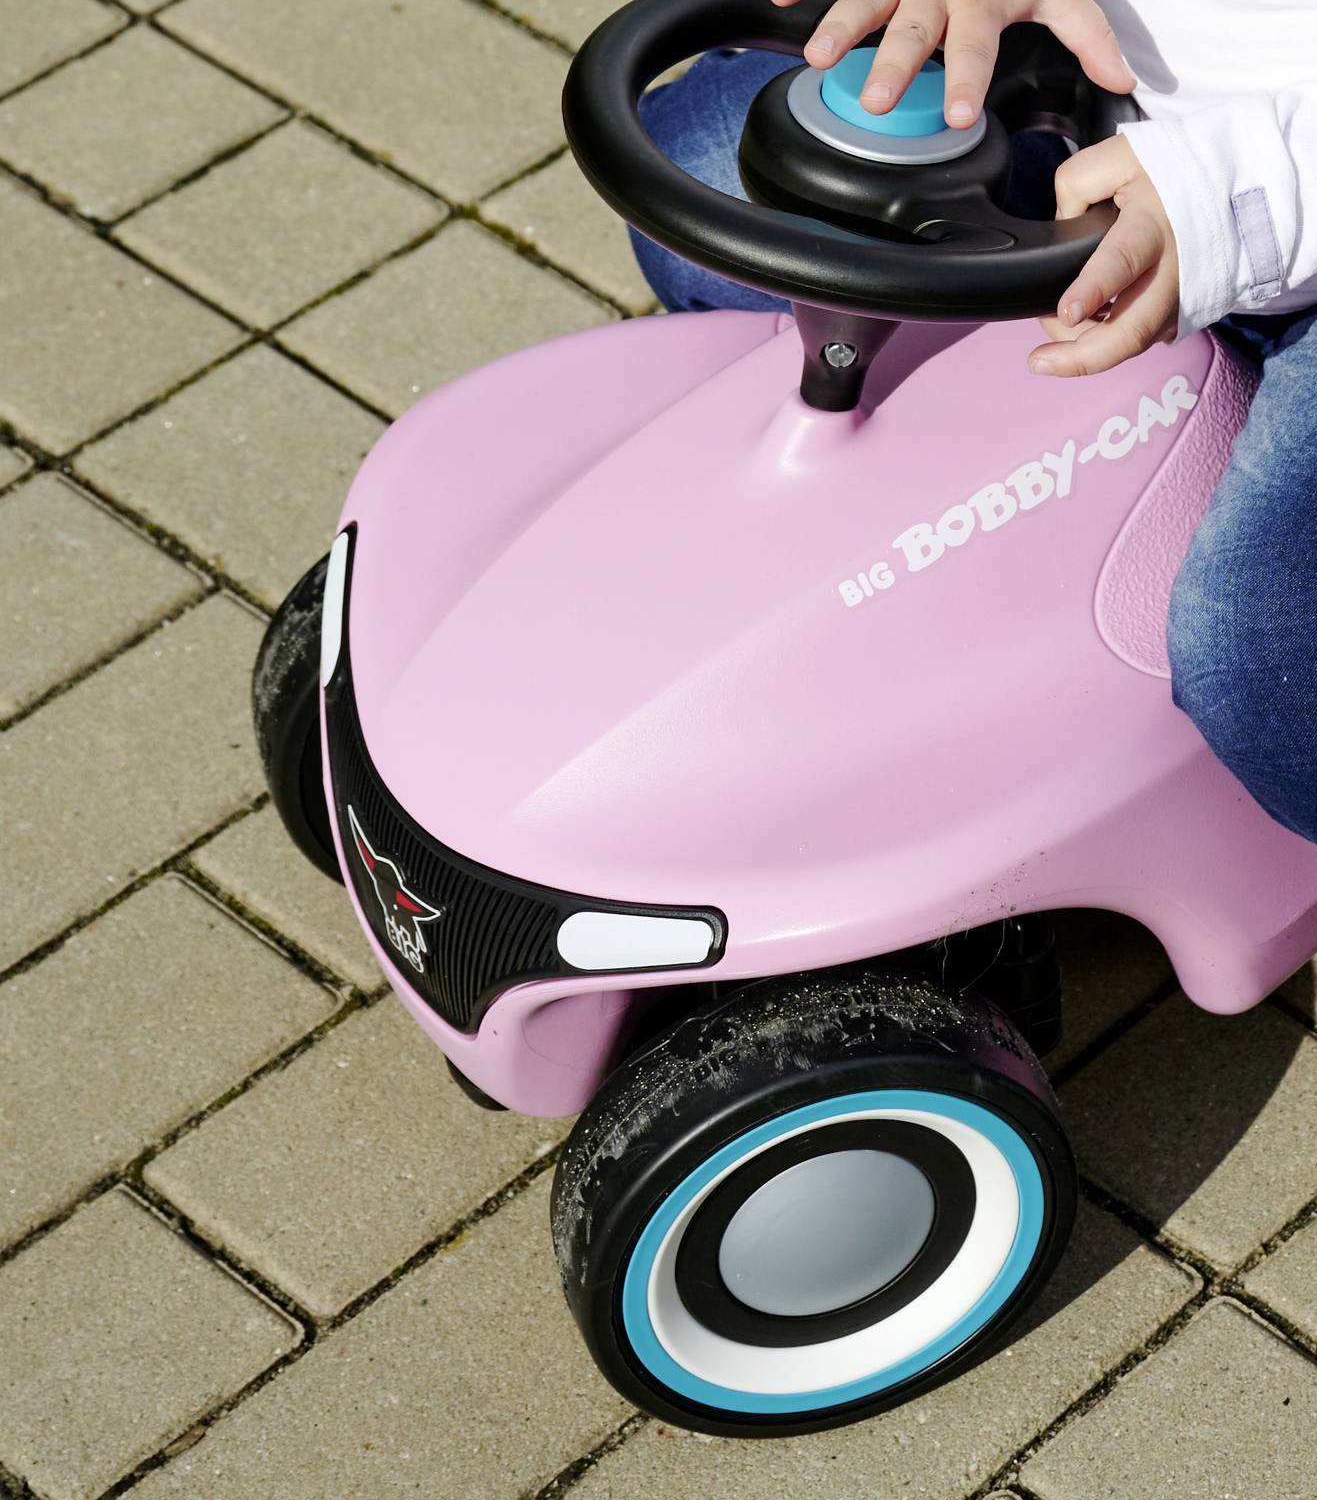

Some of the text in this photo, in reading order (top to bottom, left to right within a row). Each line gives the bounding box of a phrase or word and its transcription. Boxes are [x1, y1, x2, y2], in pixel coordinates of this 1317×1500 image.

[837, 374, 1199, 608] BIG BOBBY-CAR
[384, 915, 425, 974] BIG
